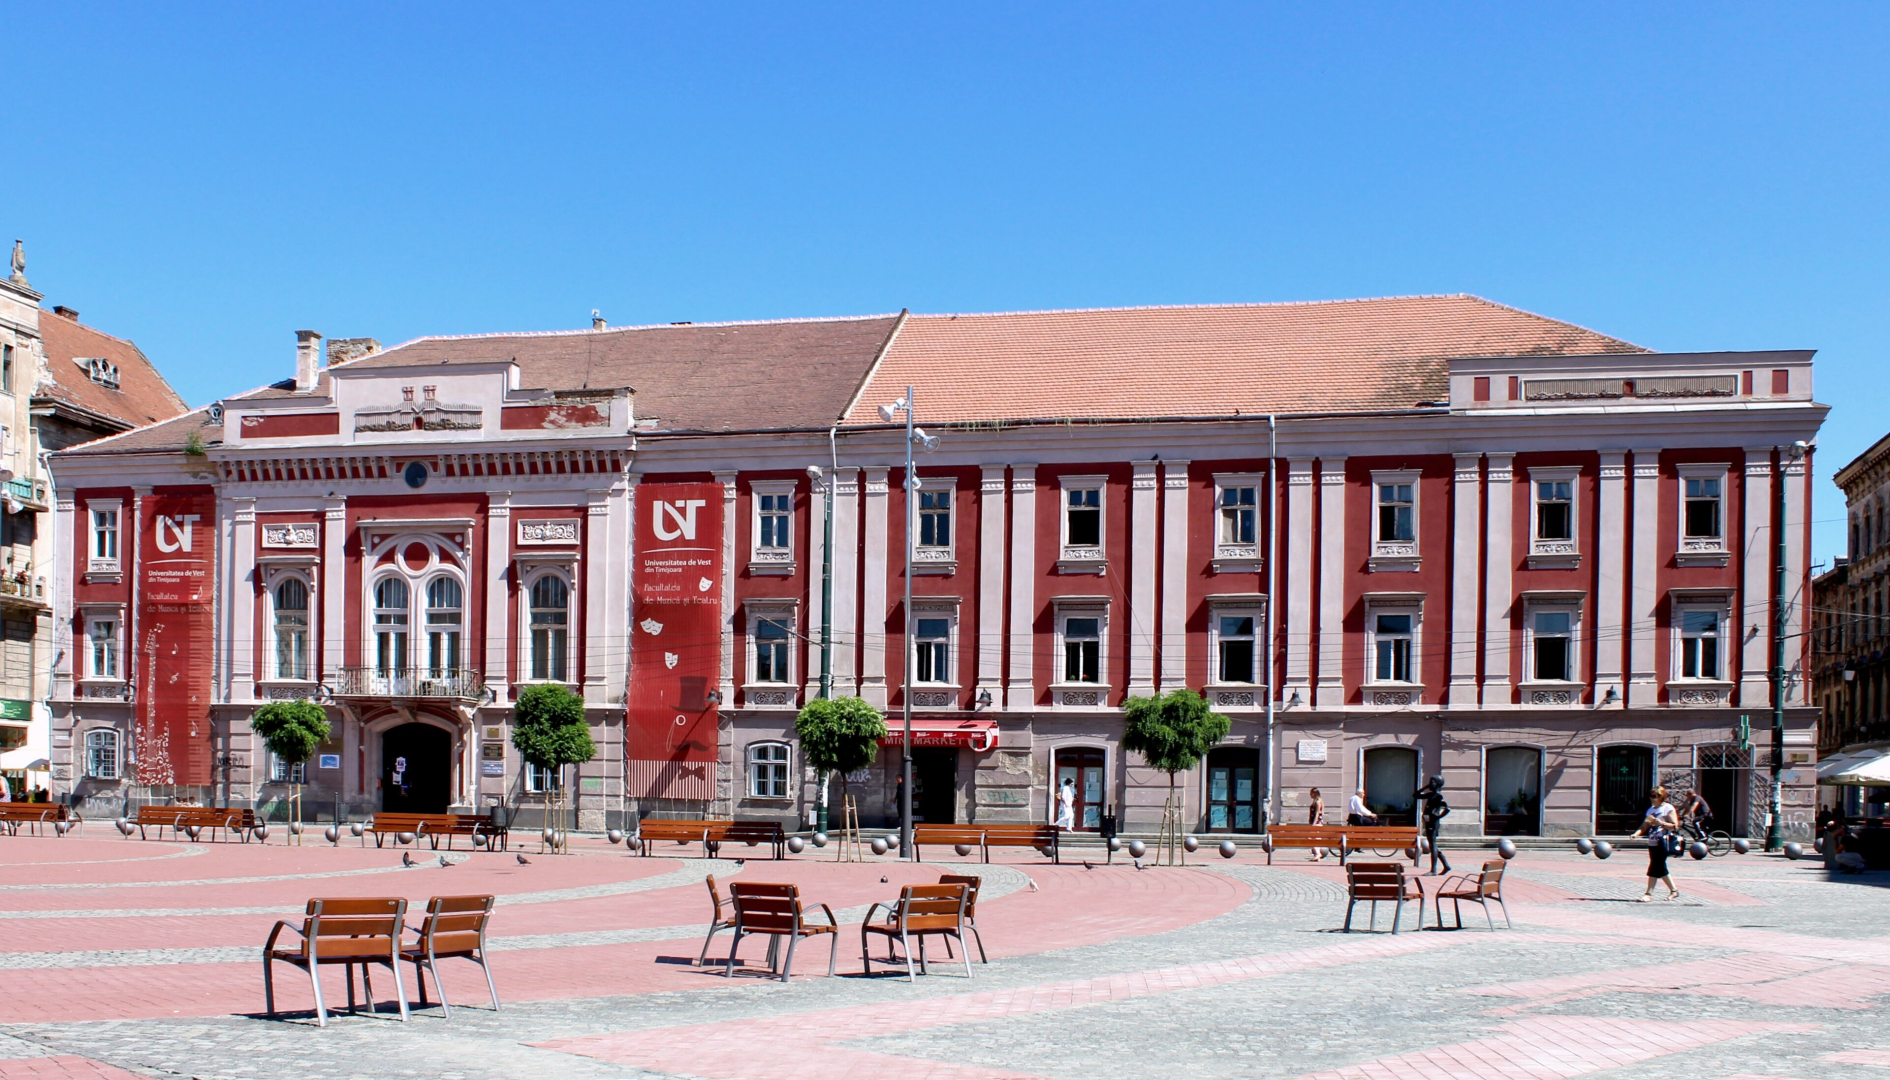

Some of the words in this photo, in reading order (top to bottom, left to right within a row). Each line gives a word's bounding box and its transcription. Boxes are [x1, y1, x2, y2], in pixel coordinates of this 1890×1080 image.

[643, 584, 681, 592] Facultatea
[643, 596, 654, 605] de
[692, 596, 718, 605] Teatru
[884, 737, 910, 745] MIN
[913, 737, 963, 745] MARKET
